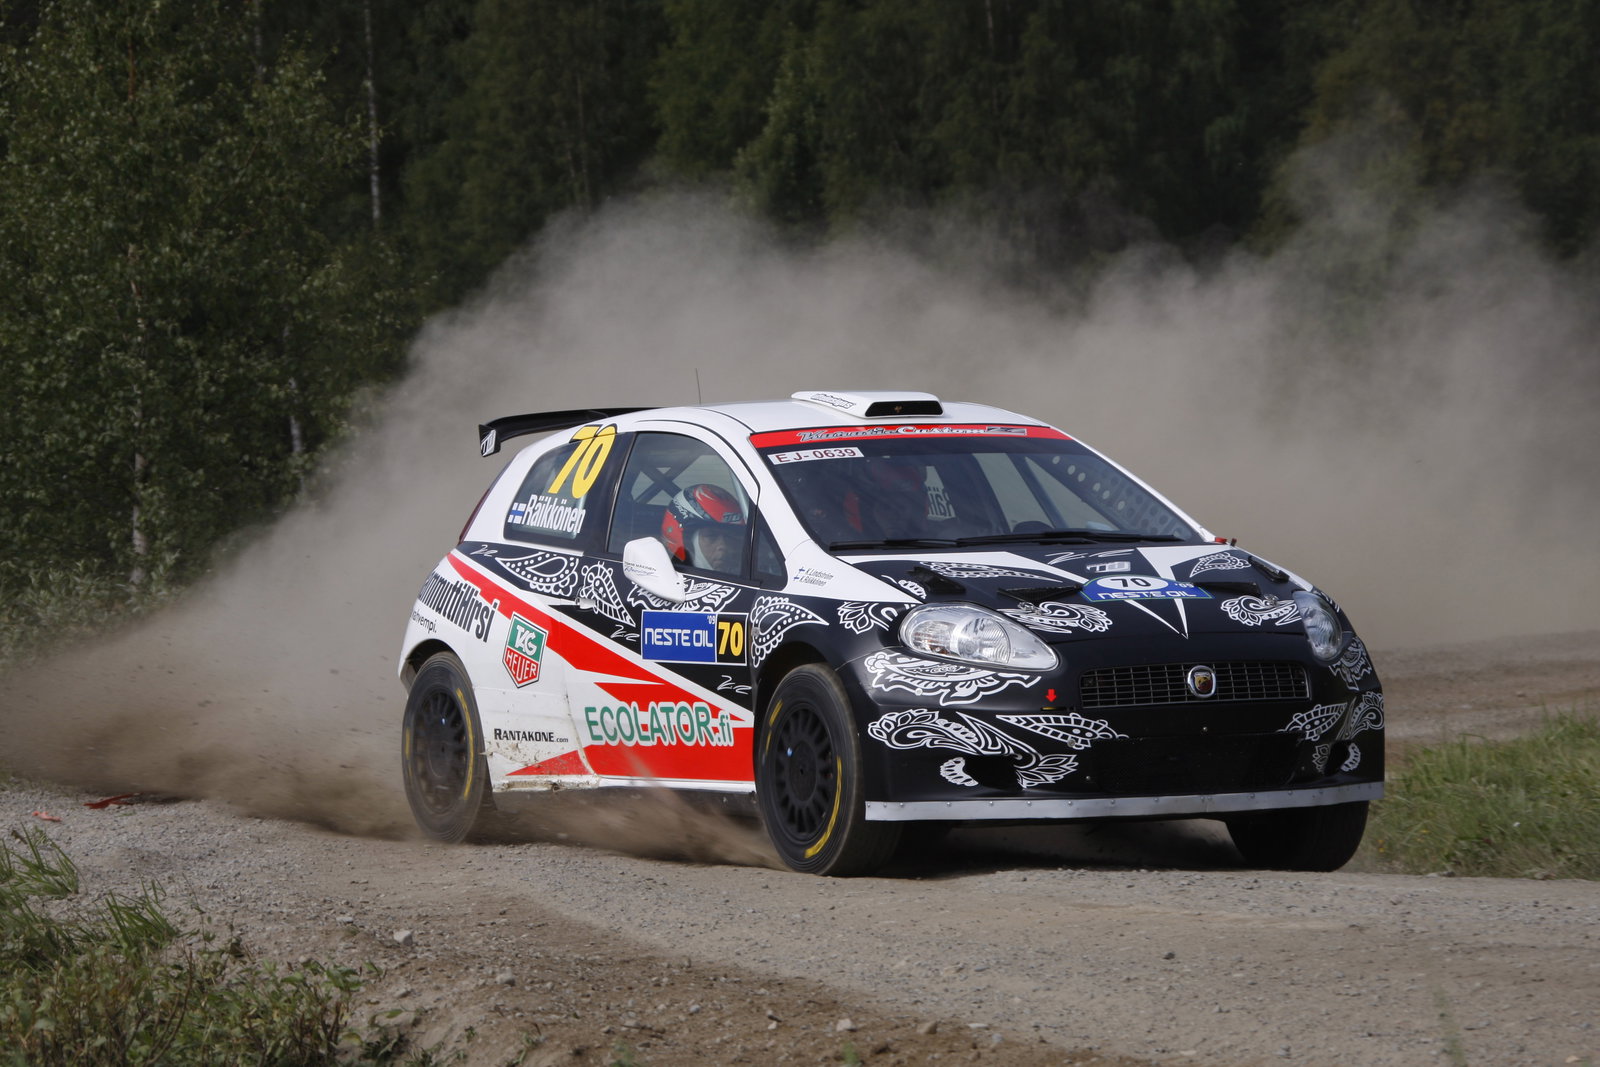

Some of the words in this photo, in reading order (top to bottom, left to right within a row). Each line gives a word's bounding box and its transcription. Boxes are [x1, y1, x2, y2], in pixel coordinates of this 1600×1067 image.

[548, 424, 617, 499] 70
[522, 494, 586, 534] Räikkönen
[1097, 590, 1164, 600] NESTE
[1165, 590, 1197, 598] OIL
[1110, 578, 1151, 588] 70
[514, 624, 537, 656] TAG
[644, 628, 691, 647] NESTE
[692, 629, 714, 647] OIL
[718, 622, 743, 656] 70
[506, 649, 537, 682] HEUER
[584, 705, 734, 743] ECOLATOR.fi
